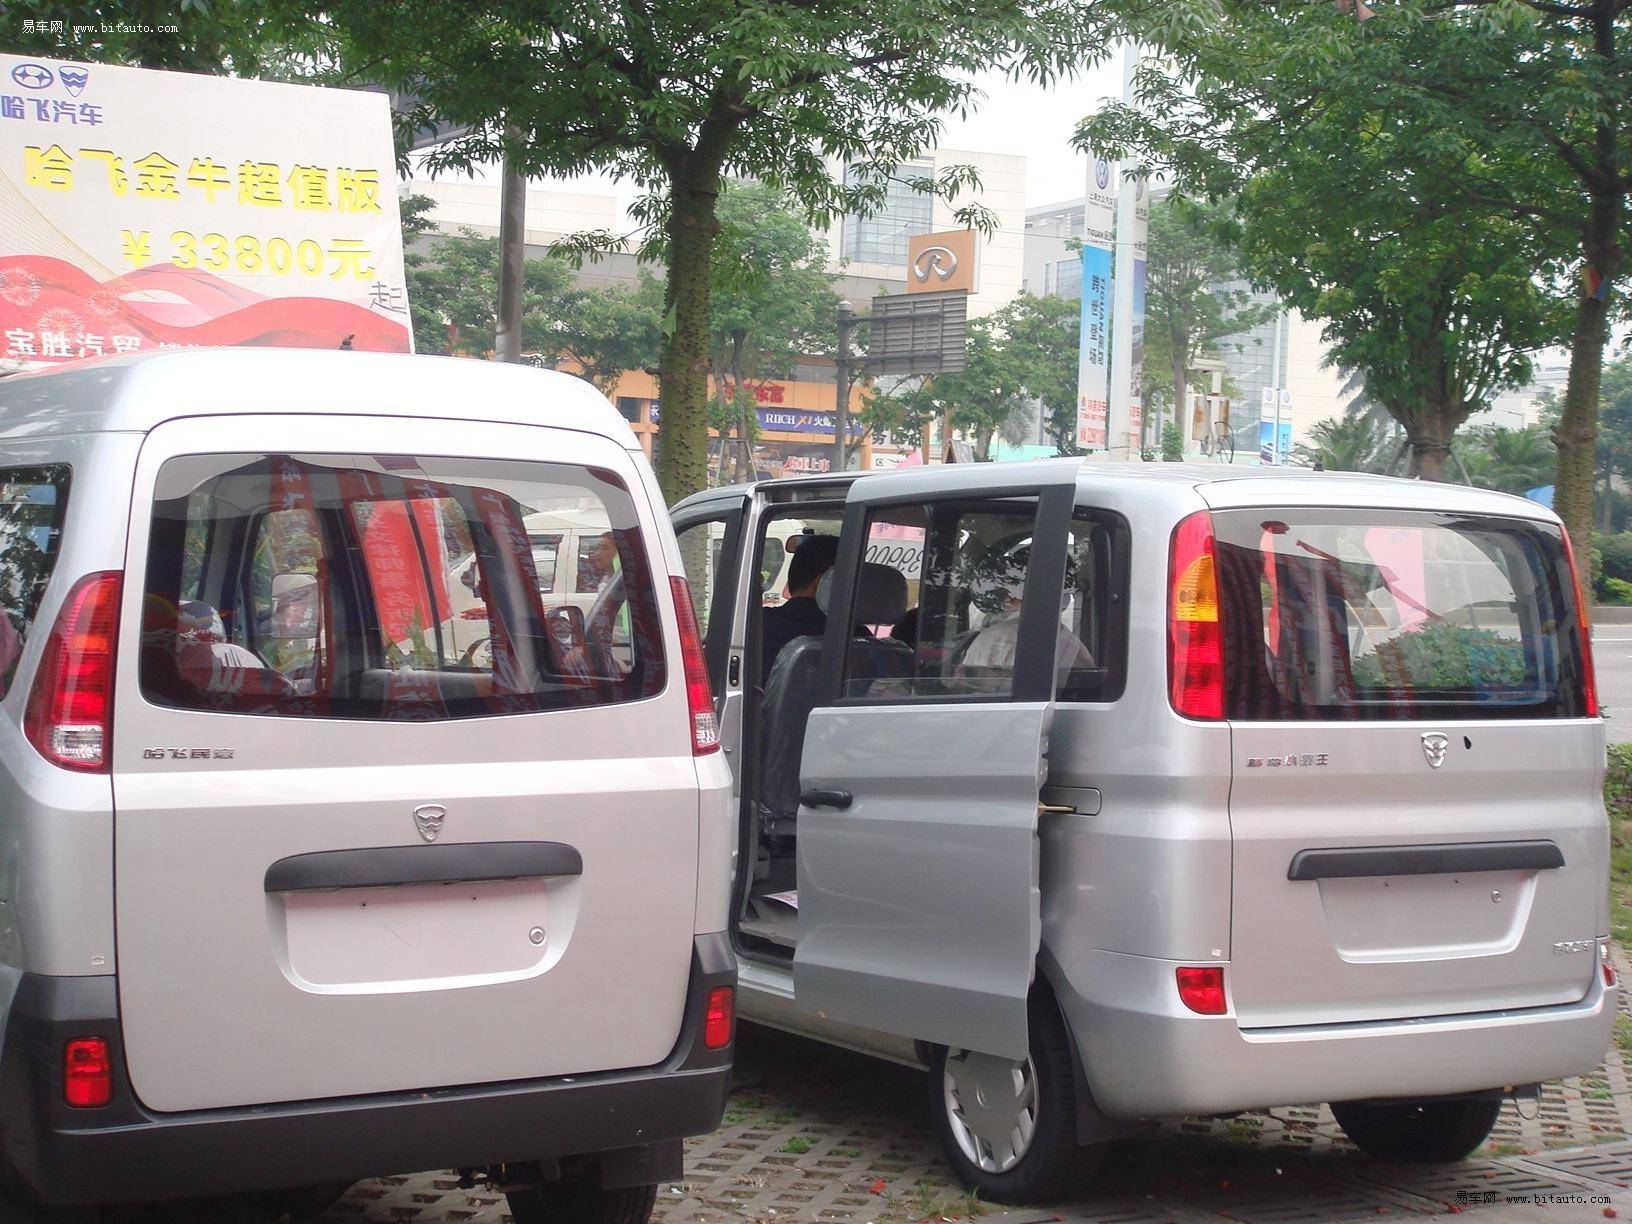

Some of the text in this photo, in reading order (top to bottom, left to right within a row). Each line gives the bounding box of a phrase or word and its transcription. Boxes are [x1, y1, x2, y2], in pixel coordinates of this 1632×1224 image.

[0, 95, 103, 126] 哈飞汽车
[24, 144, 383, 214] 哈飞金牛超值版
[369, 281, 407, 315] 起
[765, 413, 796, 425] RIICH
